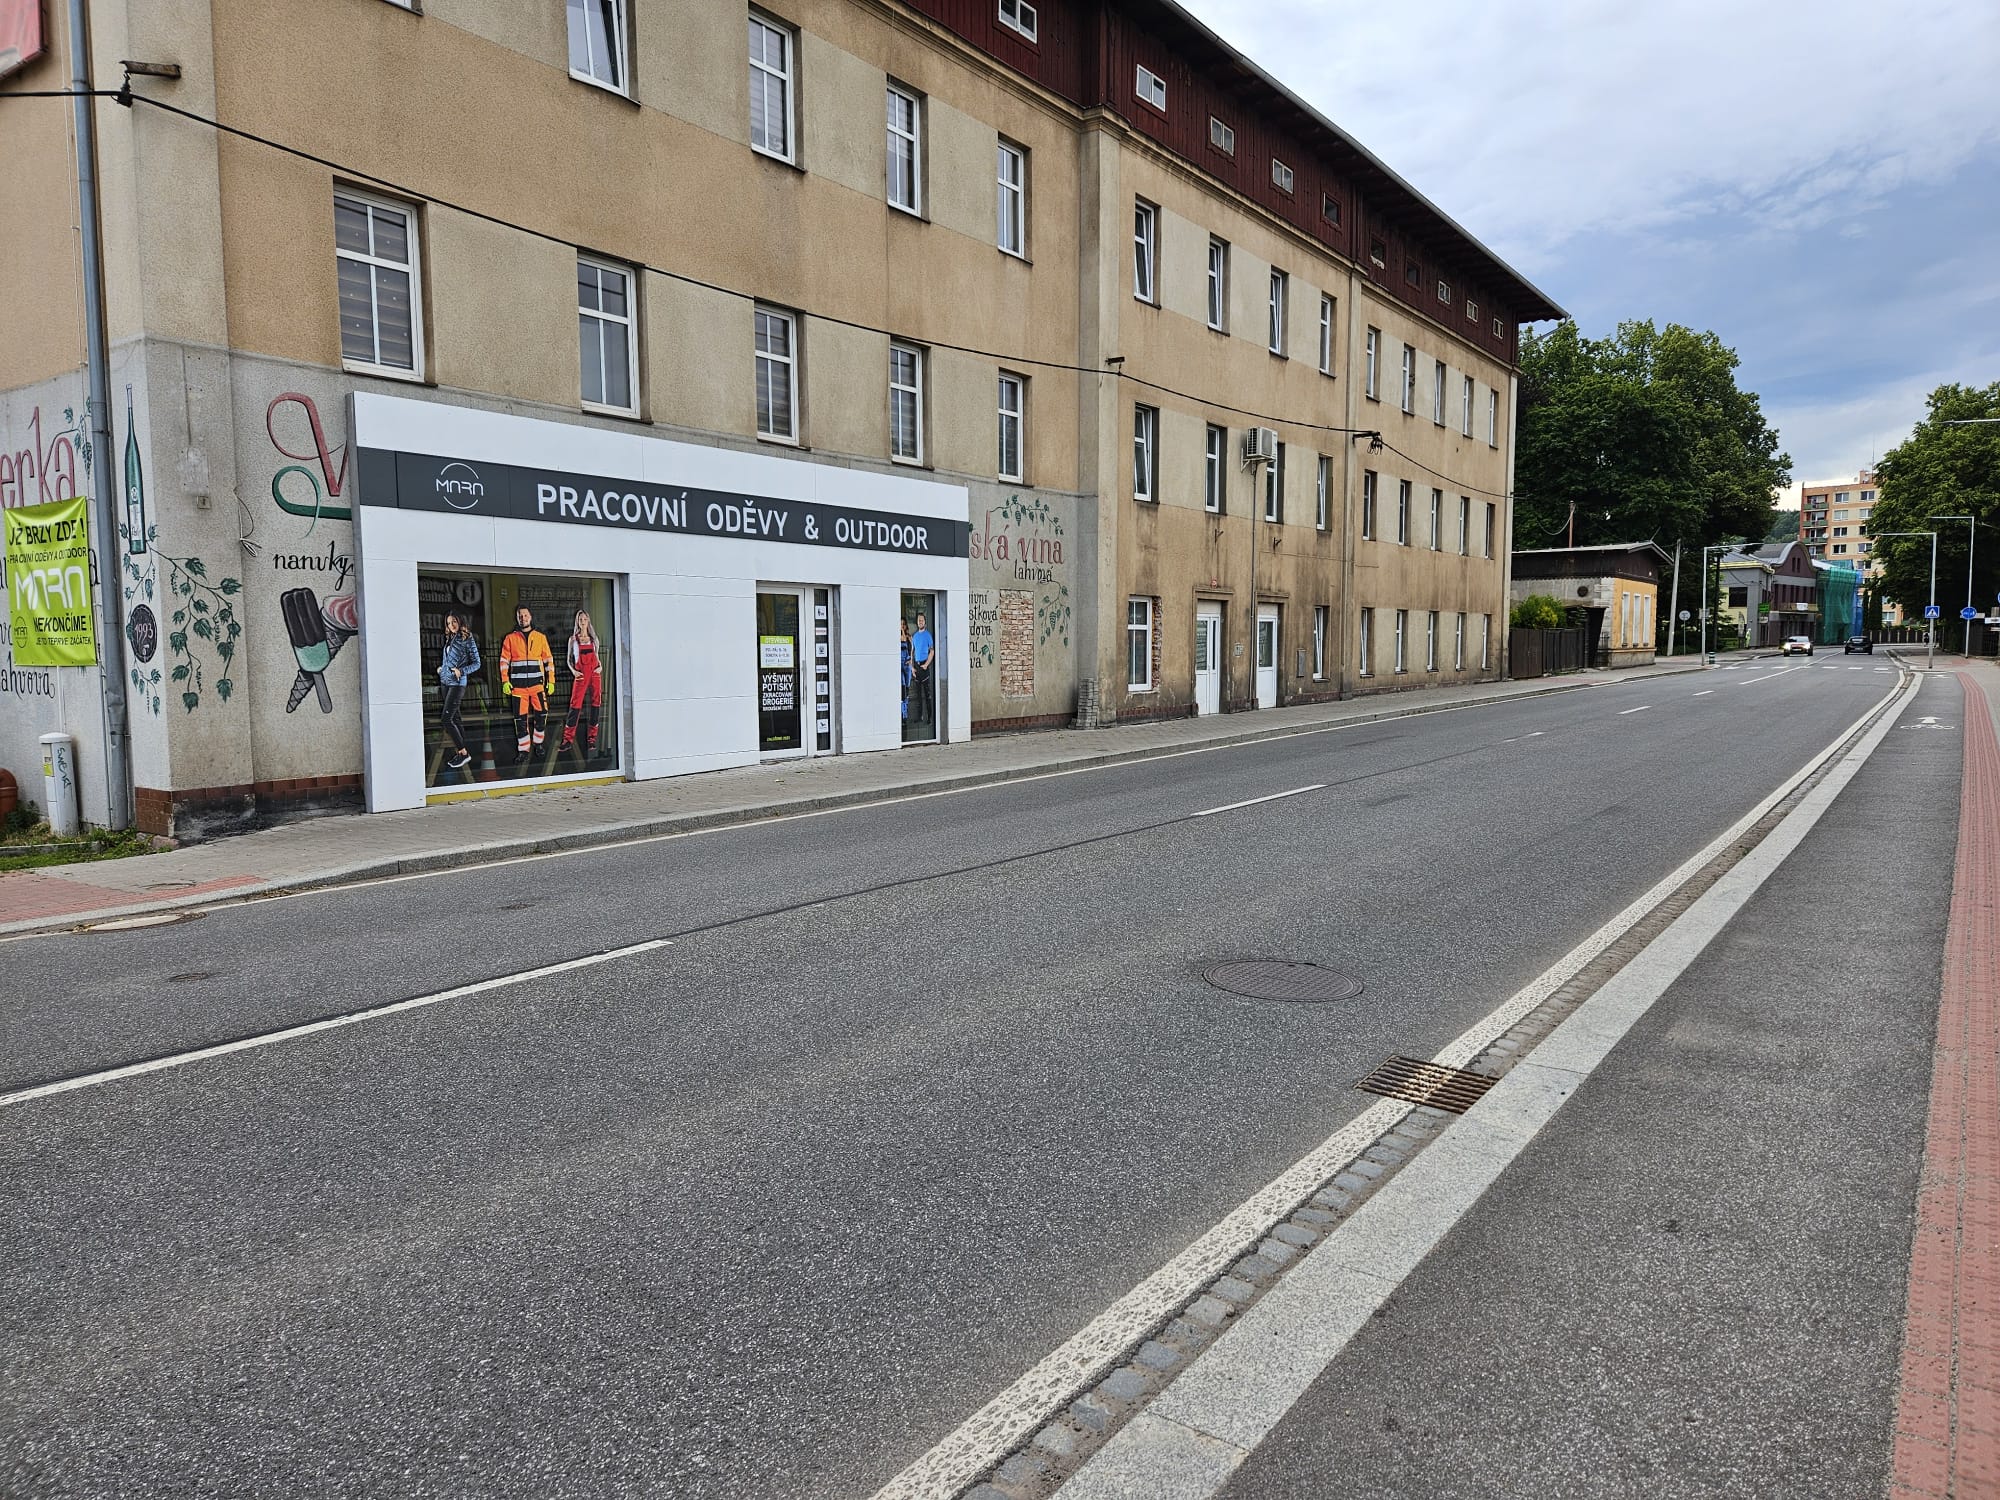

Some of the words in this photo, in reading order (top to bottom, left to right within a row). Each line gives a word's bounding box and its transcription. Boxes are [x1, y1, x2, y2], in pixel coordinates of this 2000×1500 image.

[537, 483, 687, 528] PRACOVNÍ
[706, 500, 788, 537] ODĚVY
[804, 514, 819, 540] &
[835, 517, 928, 550] OUTDOOR
[25, 524, 52, 545] BRZY
[55, 519, 77, 542] ZDE
[33, 612, 87, 633] NEKONČÍME
[762, 673, 793, 683] VÝŠIVKY
[762, 683, 793, 692] POTISKY
[762, 698, 794, 706] DROGERIE
